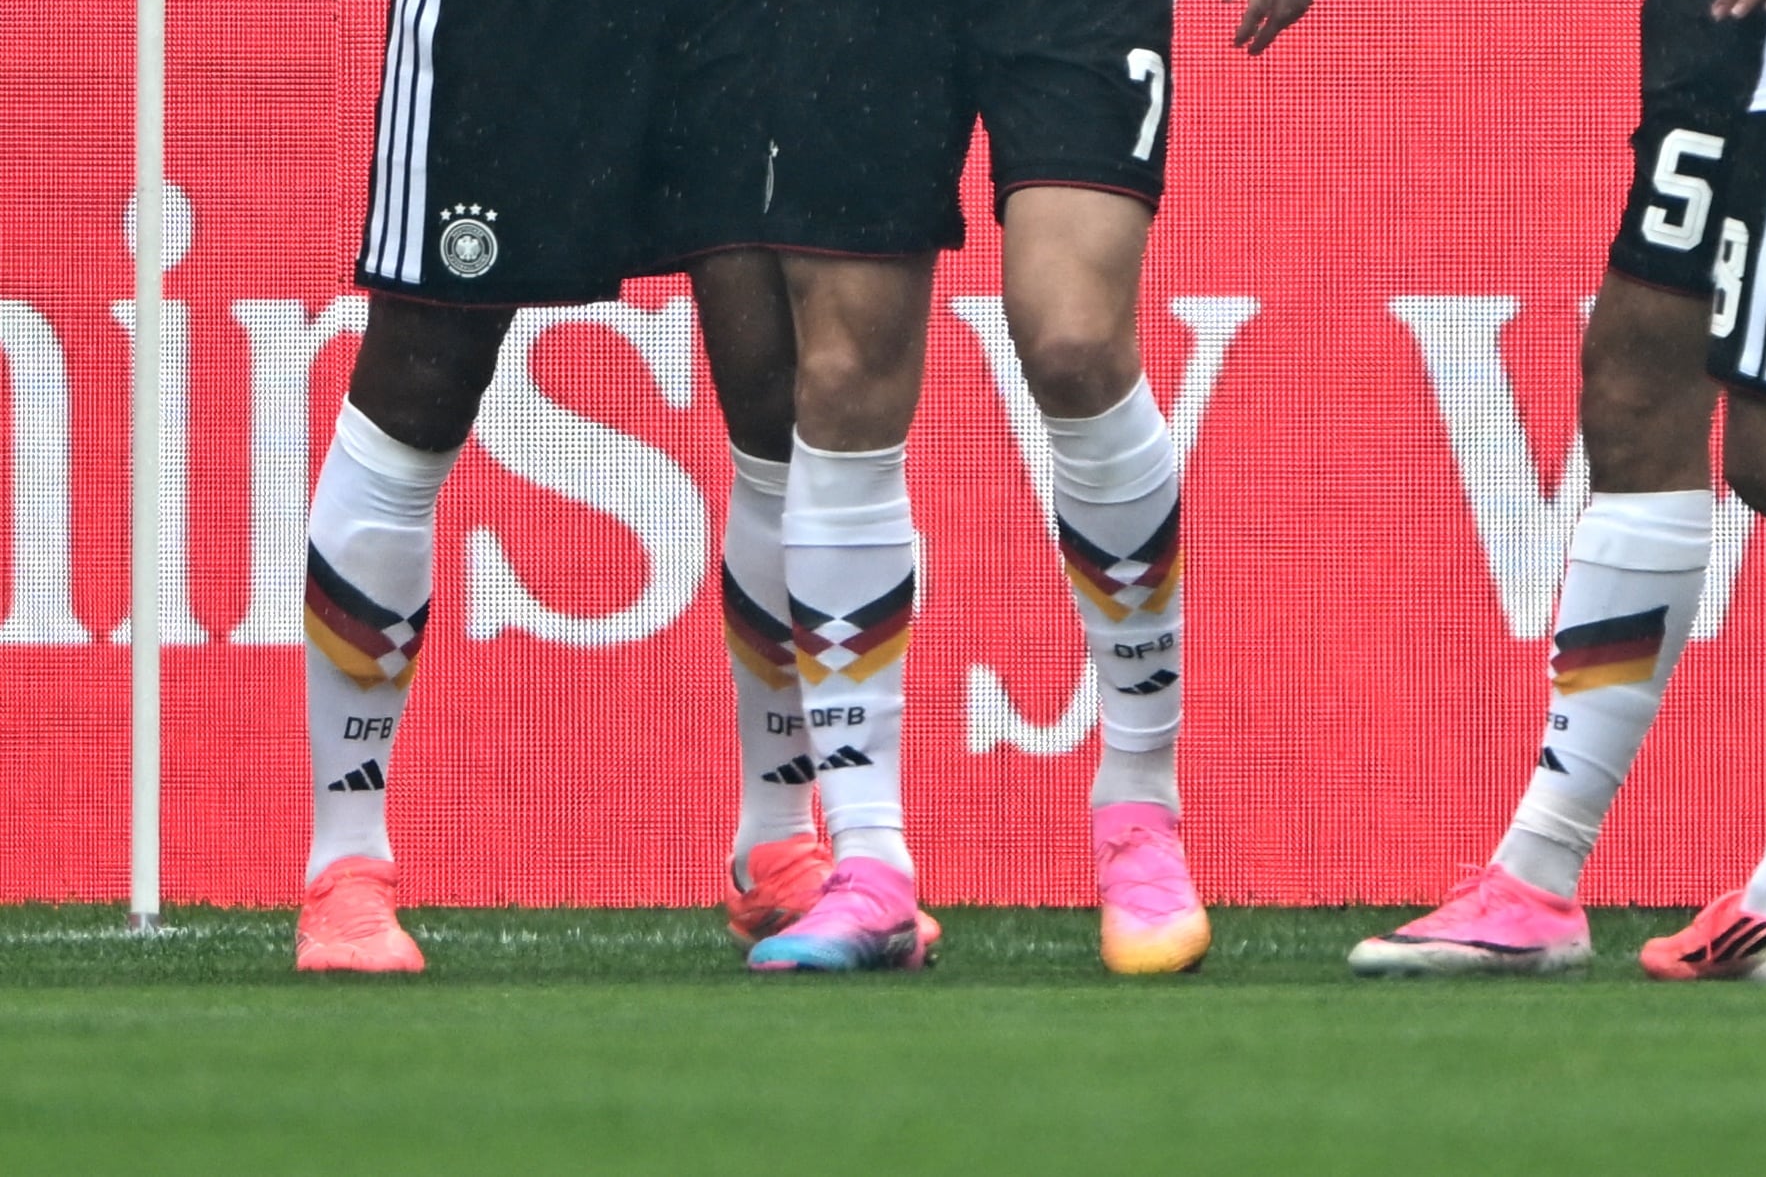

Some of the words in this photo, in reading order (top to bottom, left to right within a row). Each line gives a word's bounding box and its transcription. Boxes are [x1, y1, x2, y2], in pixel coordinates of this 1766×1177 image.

[1126, 48, 1166, 162] 7
[1640, 128, 1725, 252] 5
[1114, 632, 1175, 659] DFB
[343, 715, 394, 740] DFB
[810, 705, 866, 728] DFB
